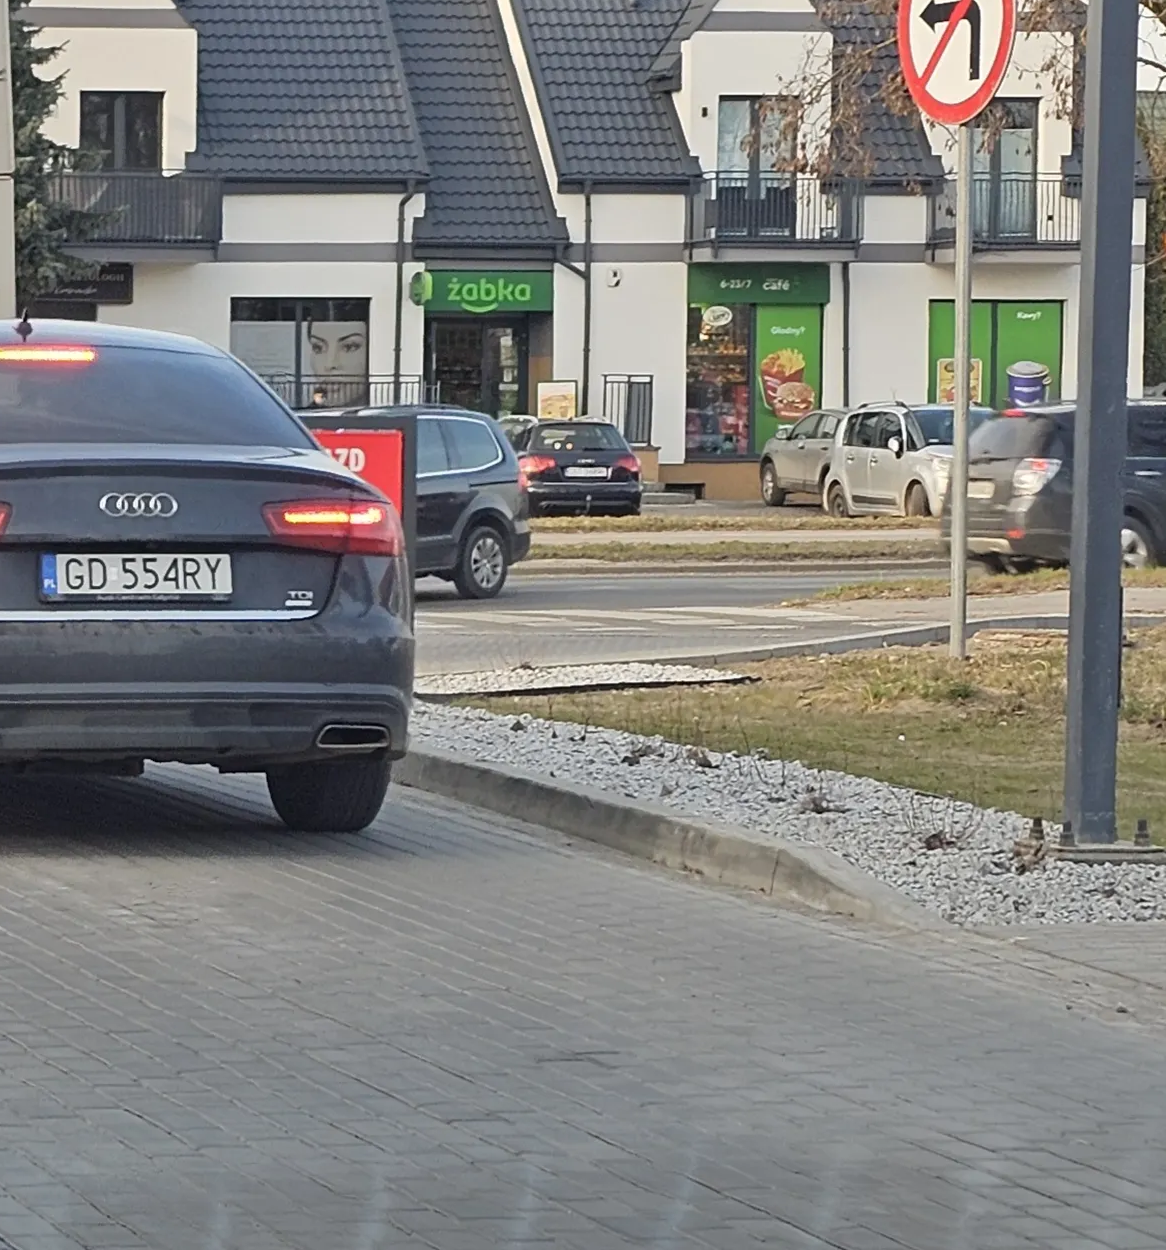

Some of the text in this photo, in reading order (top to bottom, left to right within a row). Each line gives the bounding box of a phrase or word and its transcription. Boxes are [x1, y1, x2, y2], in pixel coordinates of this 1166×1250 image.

[447, 277, 531, 302] żabka
[65, 558, 222, 590] GD 554RY
[44, 578, 56, 588] PL
[287, 591, 314, 600] TDI
